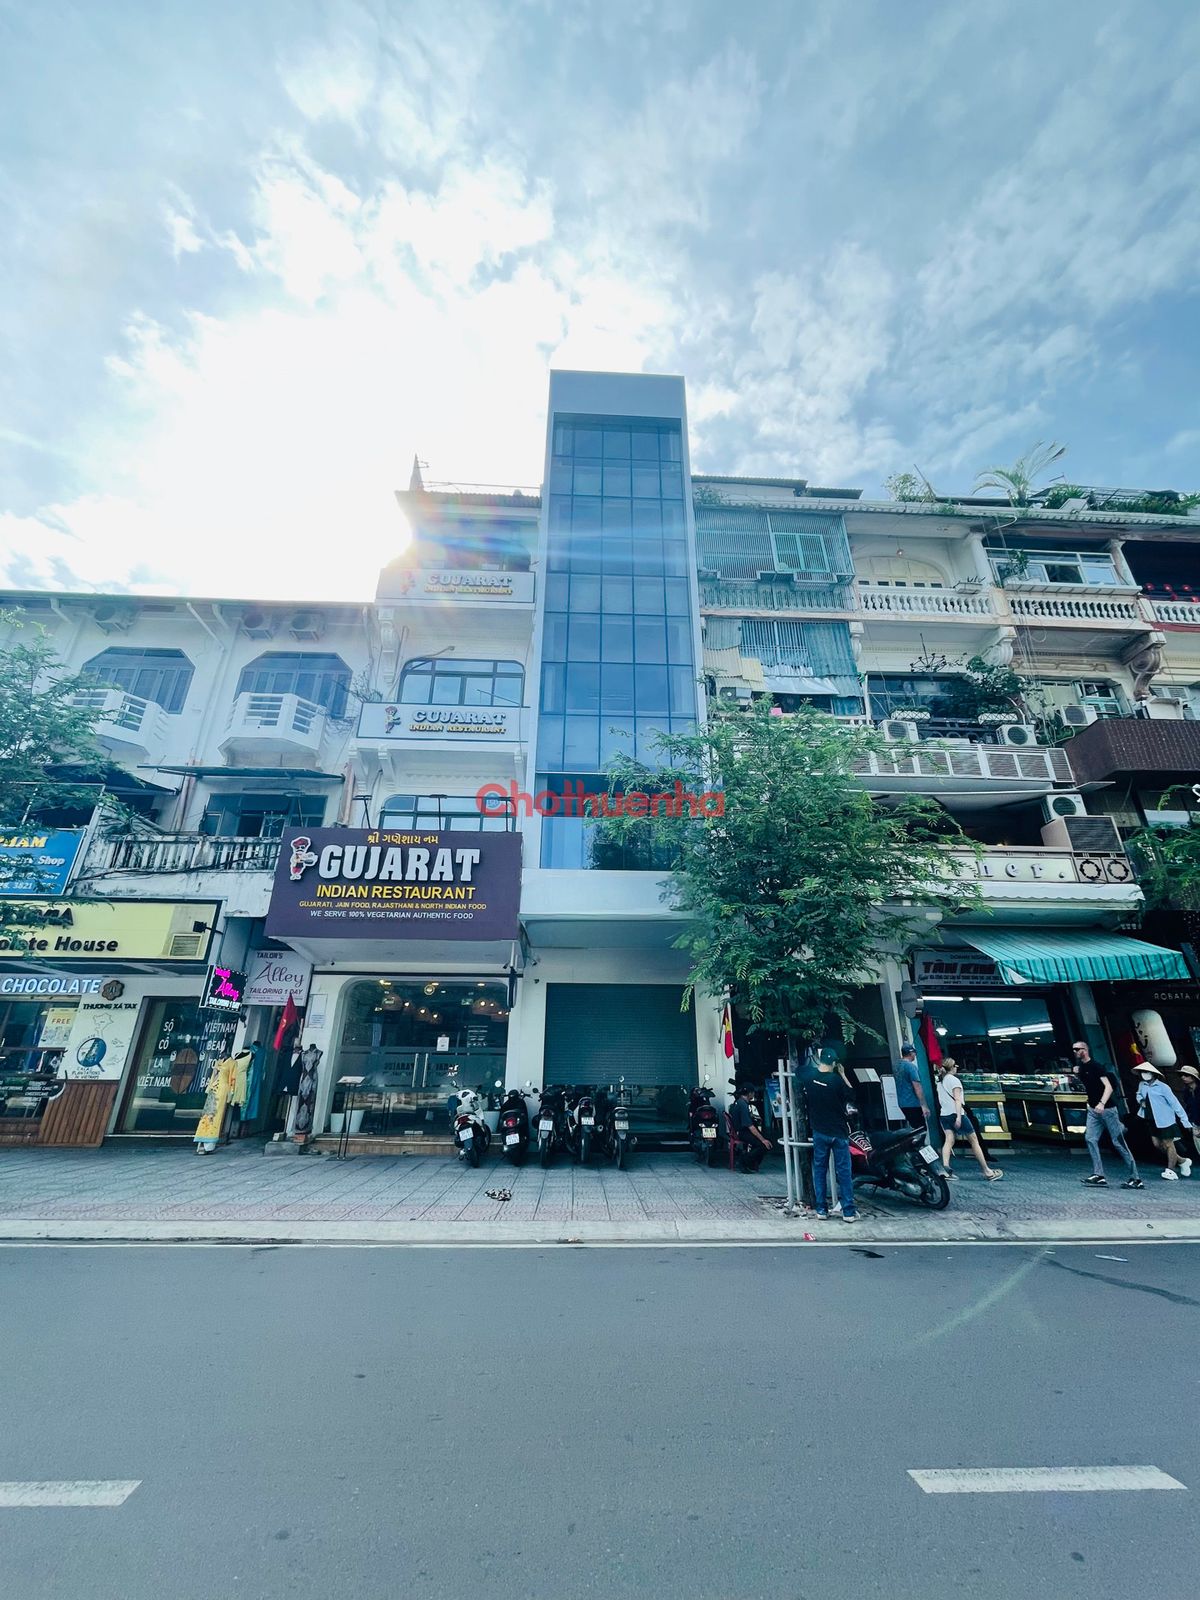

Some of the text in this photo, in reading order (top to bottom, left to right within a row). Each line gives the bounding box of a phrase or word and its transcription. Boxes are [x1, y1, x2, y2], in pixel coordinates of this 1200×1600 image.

[427, 575, 512, 587] GUJARAT
[413, 710, 506, 725] GUJARAT
[409, 724, 506, 734] INDIAN RESTAURANT
[38, 855, 65, 866] Shop
[318, 845, 481, 881] GUJARAT
[316, 885, 476, 900] INDIAN RESTAURANT
[54, 936, 119, 952] House
[1, 978, 102, 993] CHOCOLATE
[249, 987, 283, 995] TAILORING
[204, 1022, 237, 1033] VIETNAM
[154, 1076, 172, 1087] NAM
